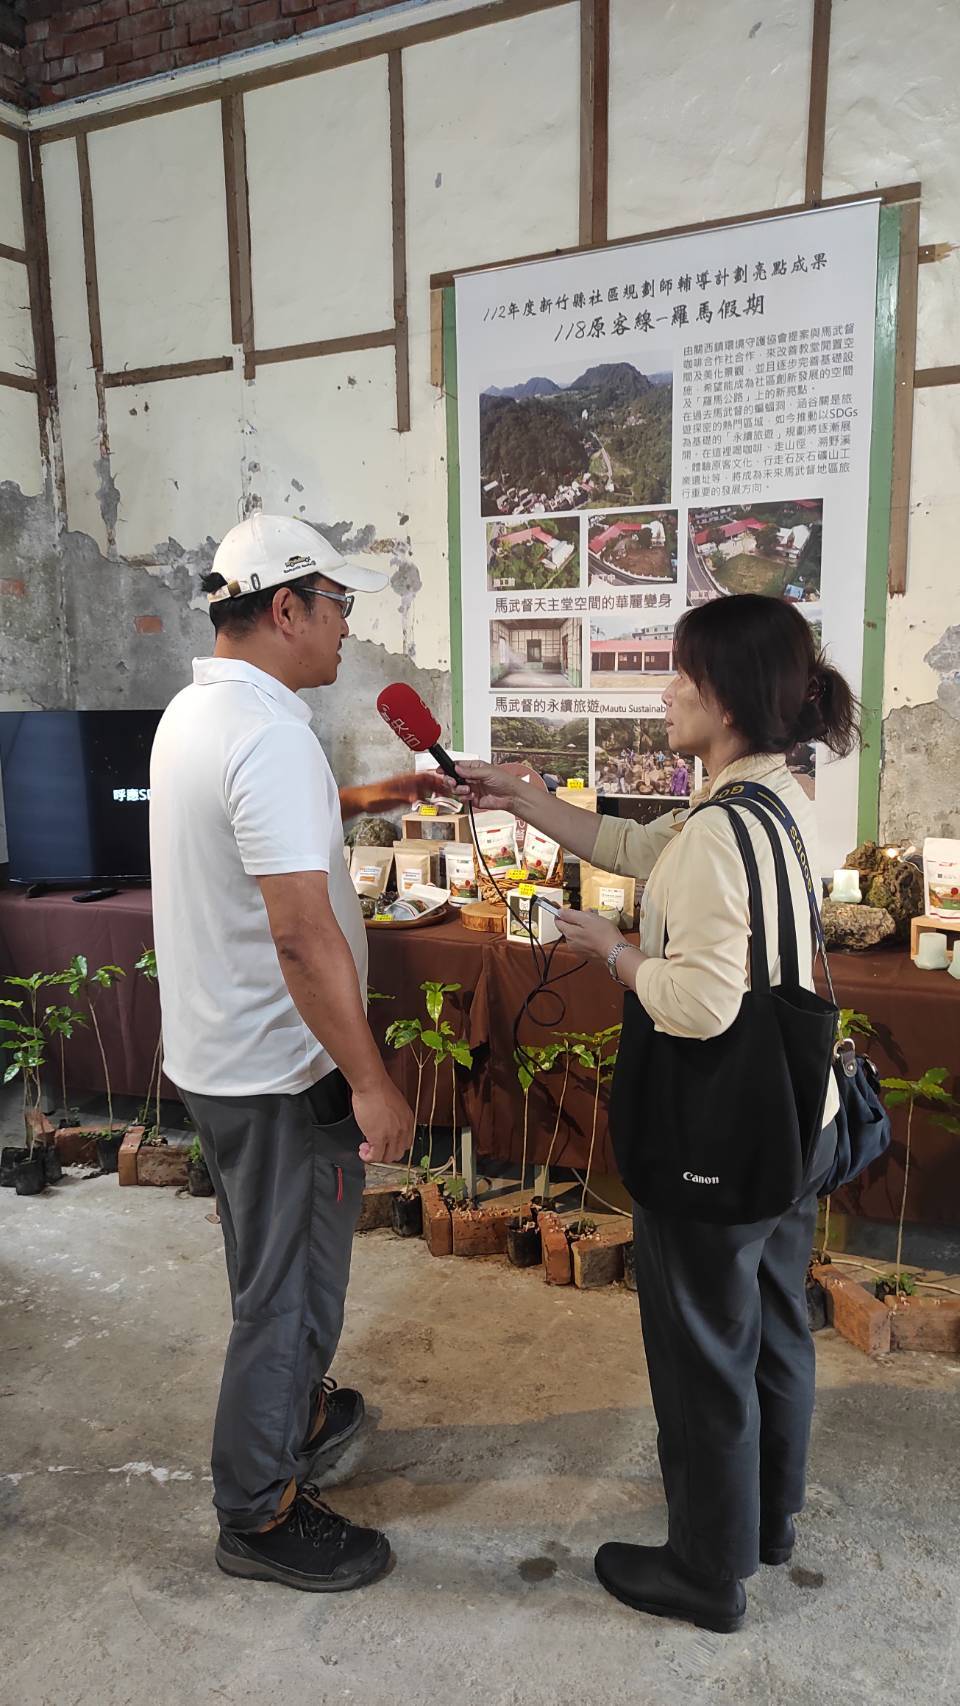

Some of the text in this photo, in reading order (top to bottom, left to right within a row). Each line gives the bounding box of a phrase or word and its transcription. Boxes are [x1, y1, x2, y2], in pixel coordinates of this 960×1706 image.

[483, 252, 828, 321] 112年度新竹縣社區規劃師輔導計劃亮點成果
[494, 593, 672, 613] 馬武督天主堂空間的華麗變身
[682, 1171, 720, 1184] Canon
